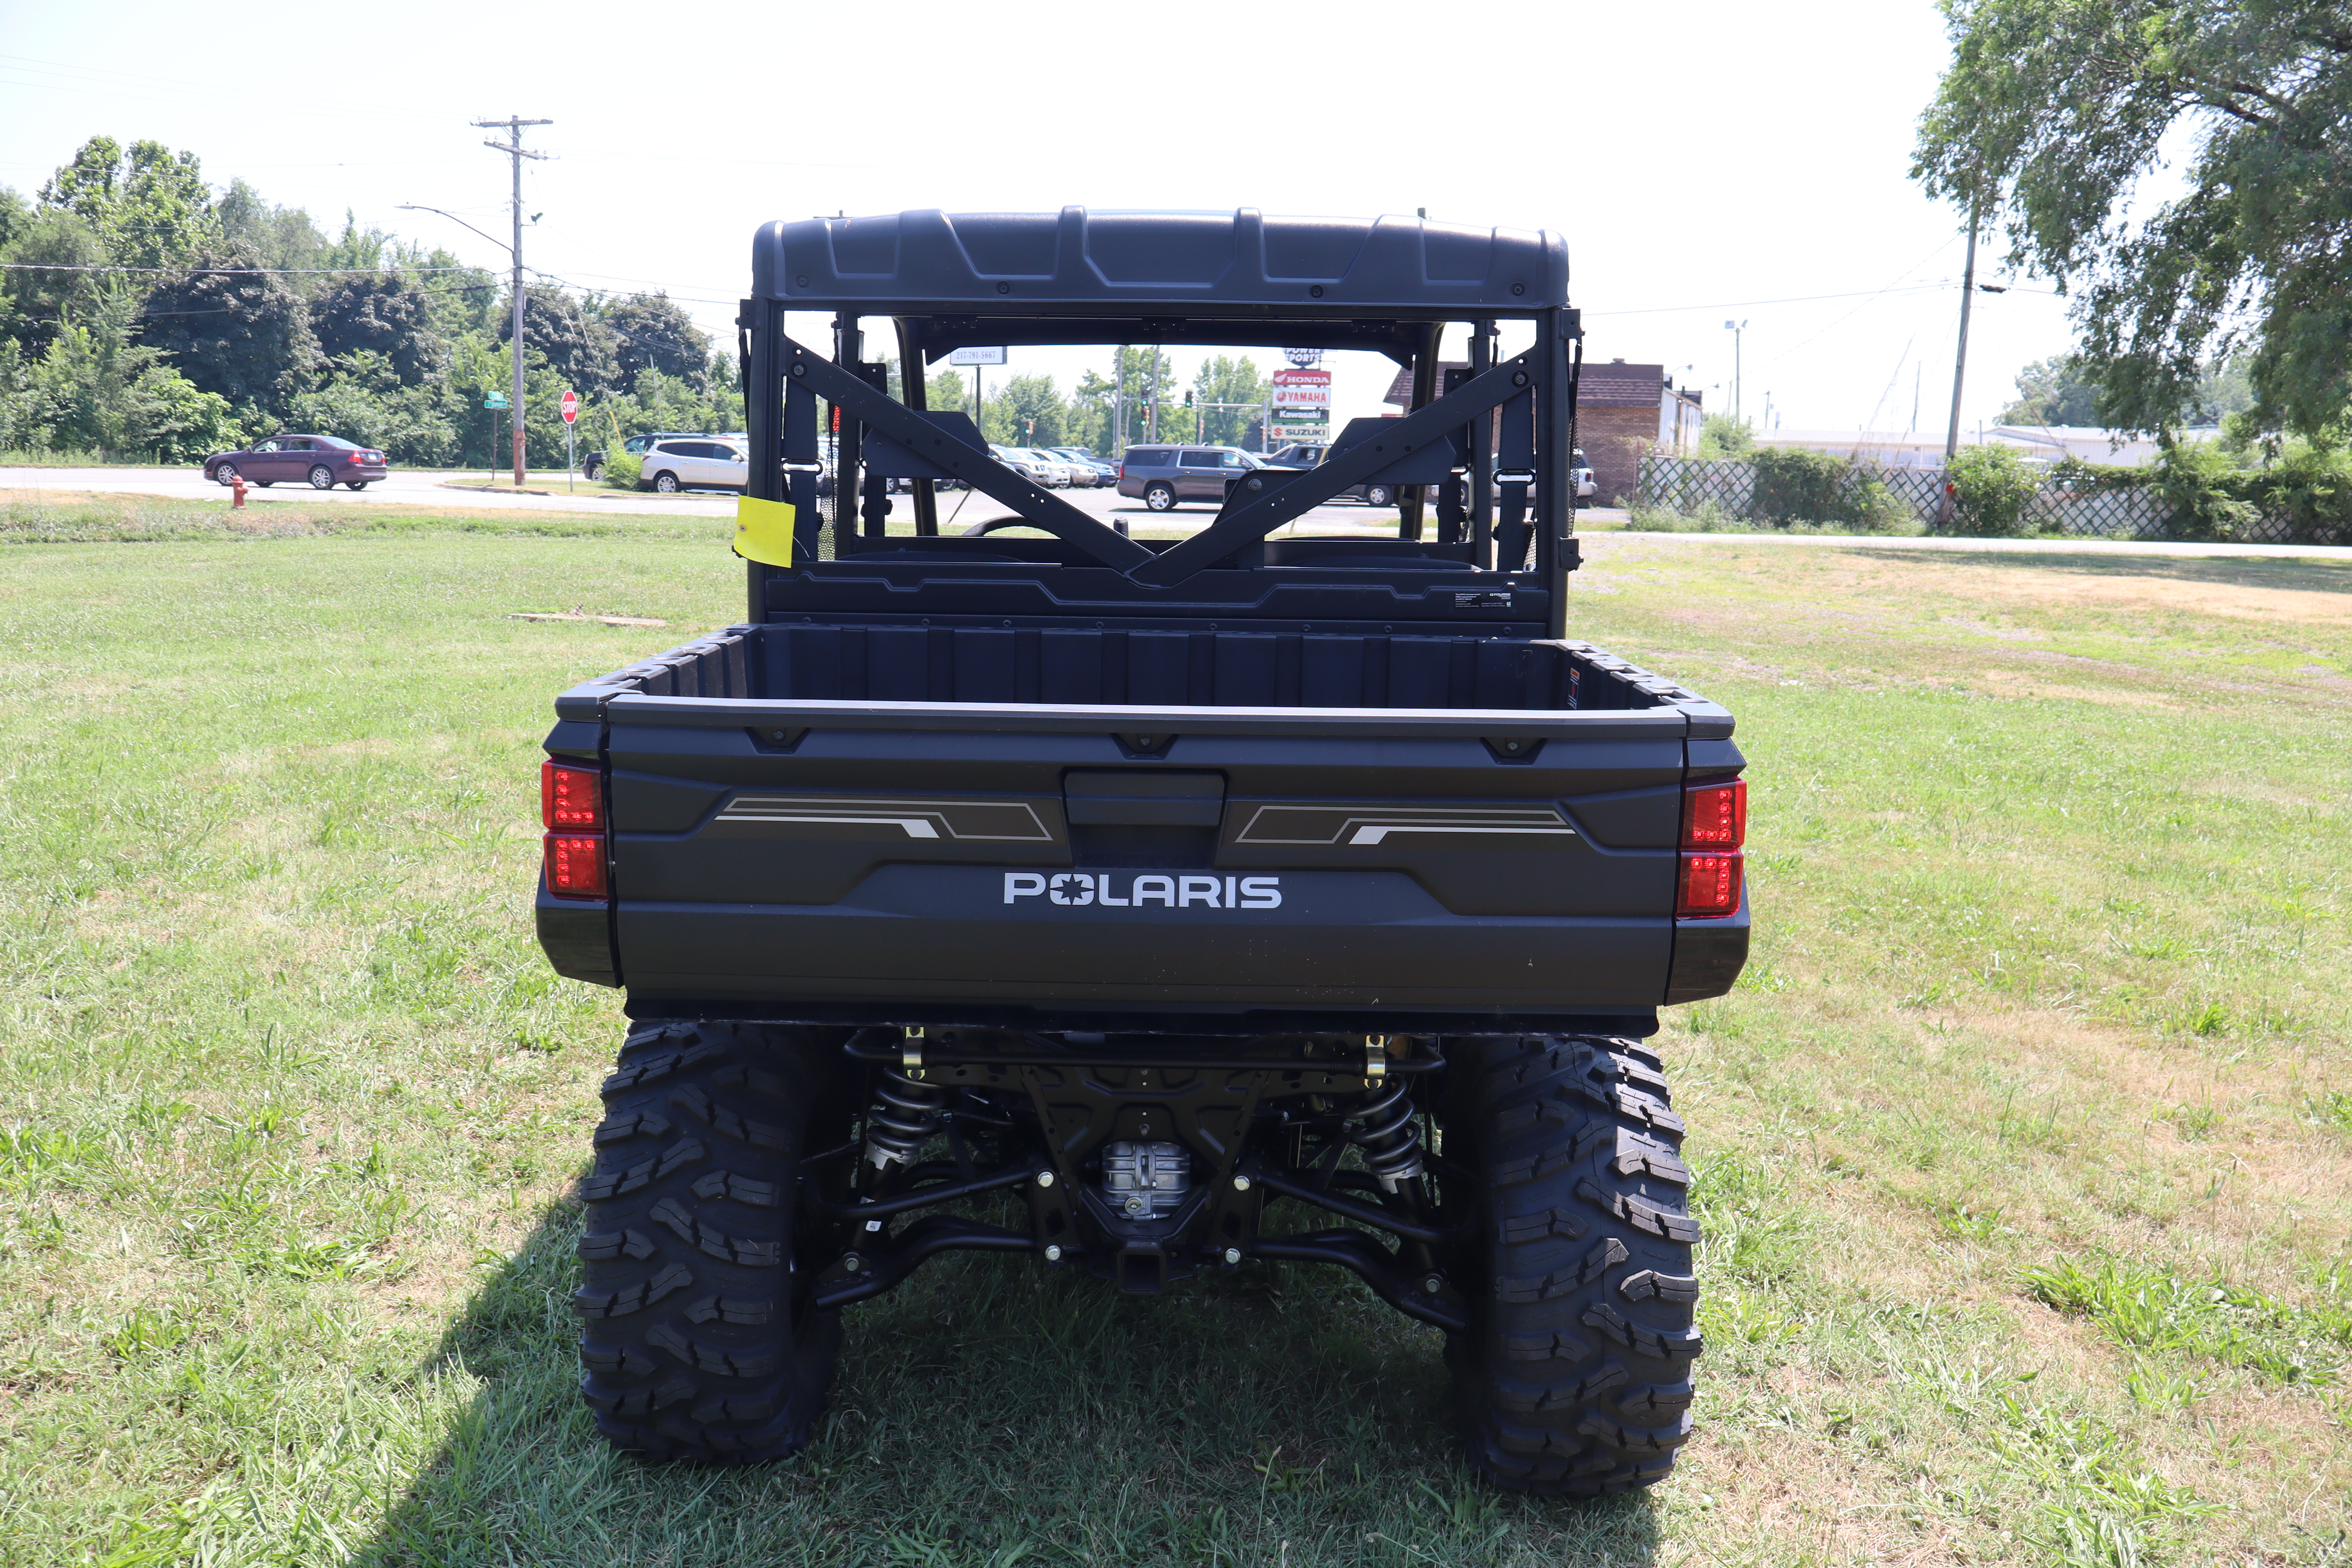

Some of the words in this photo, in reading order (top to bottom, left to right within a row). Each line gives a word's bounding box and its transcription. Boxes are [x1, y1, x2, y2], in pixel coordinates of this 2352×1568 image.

[1285, 354, 1320, 362] SPORTS
[1287, 392, 1326, 402] YAMAHA
[563, 401, 576, 414] STOP
[1004, 872, 1283, 909] POLARIS
